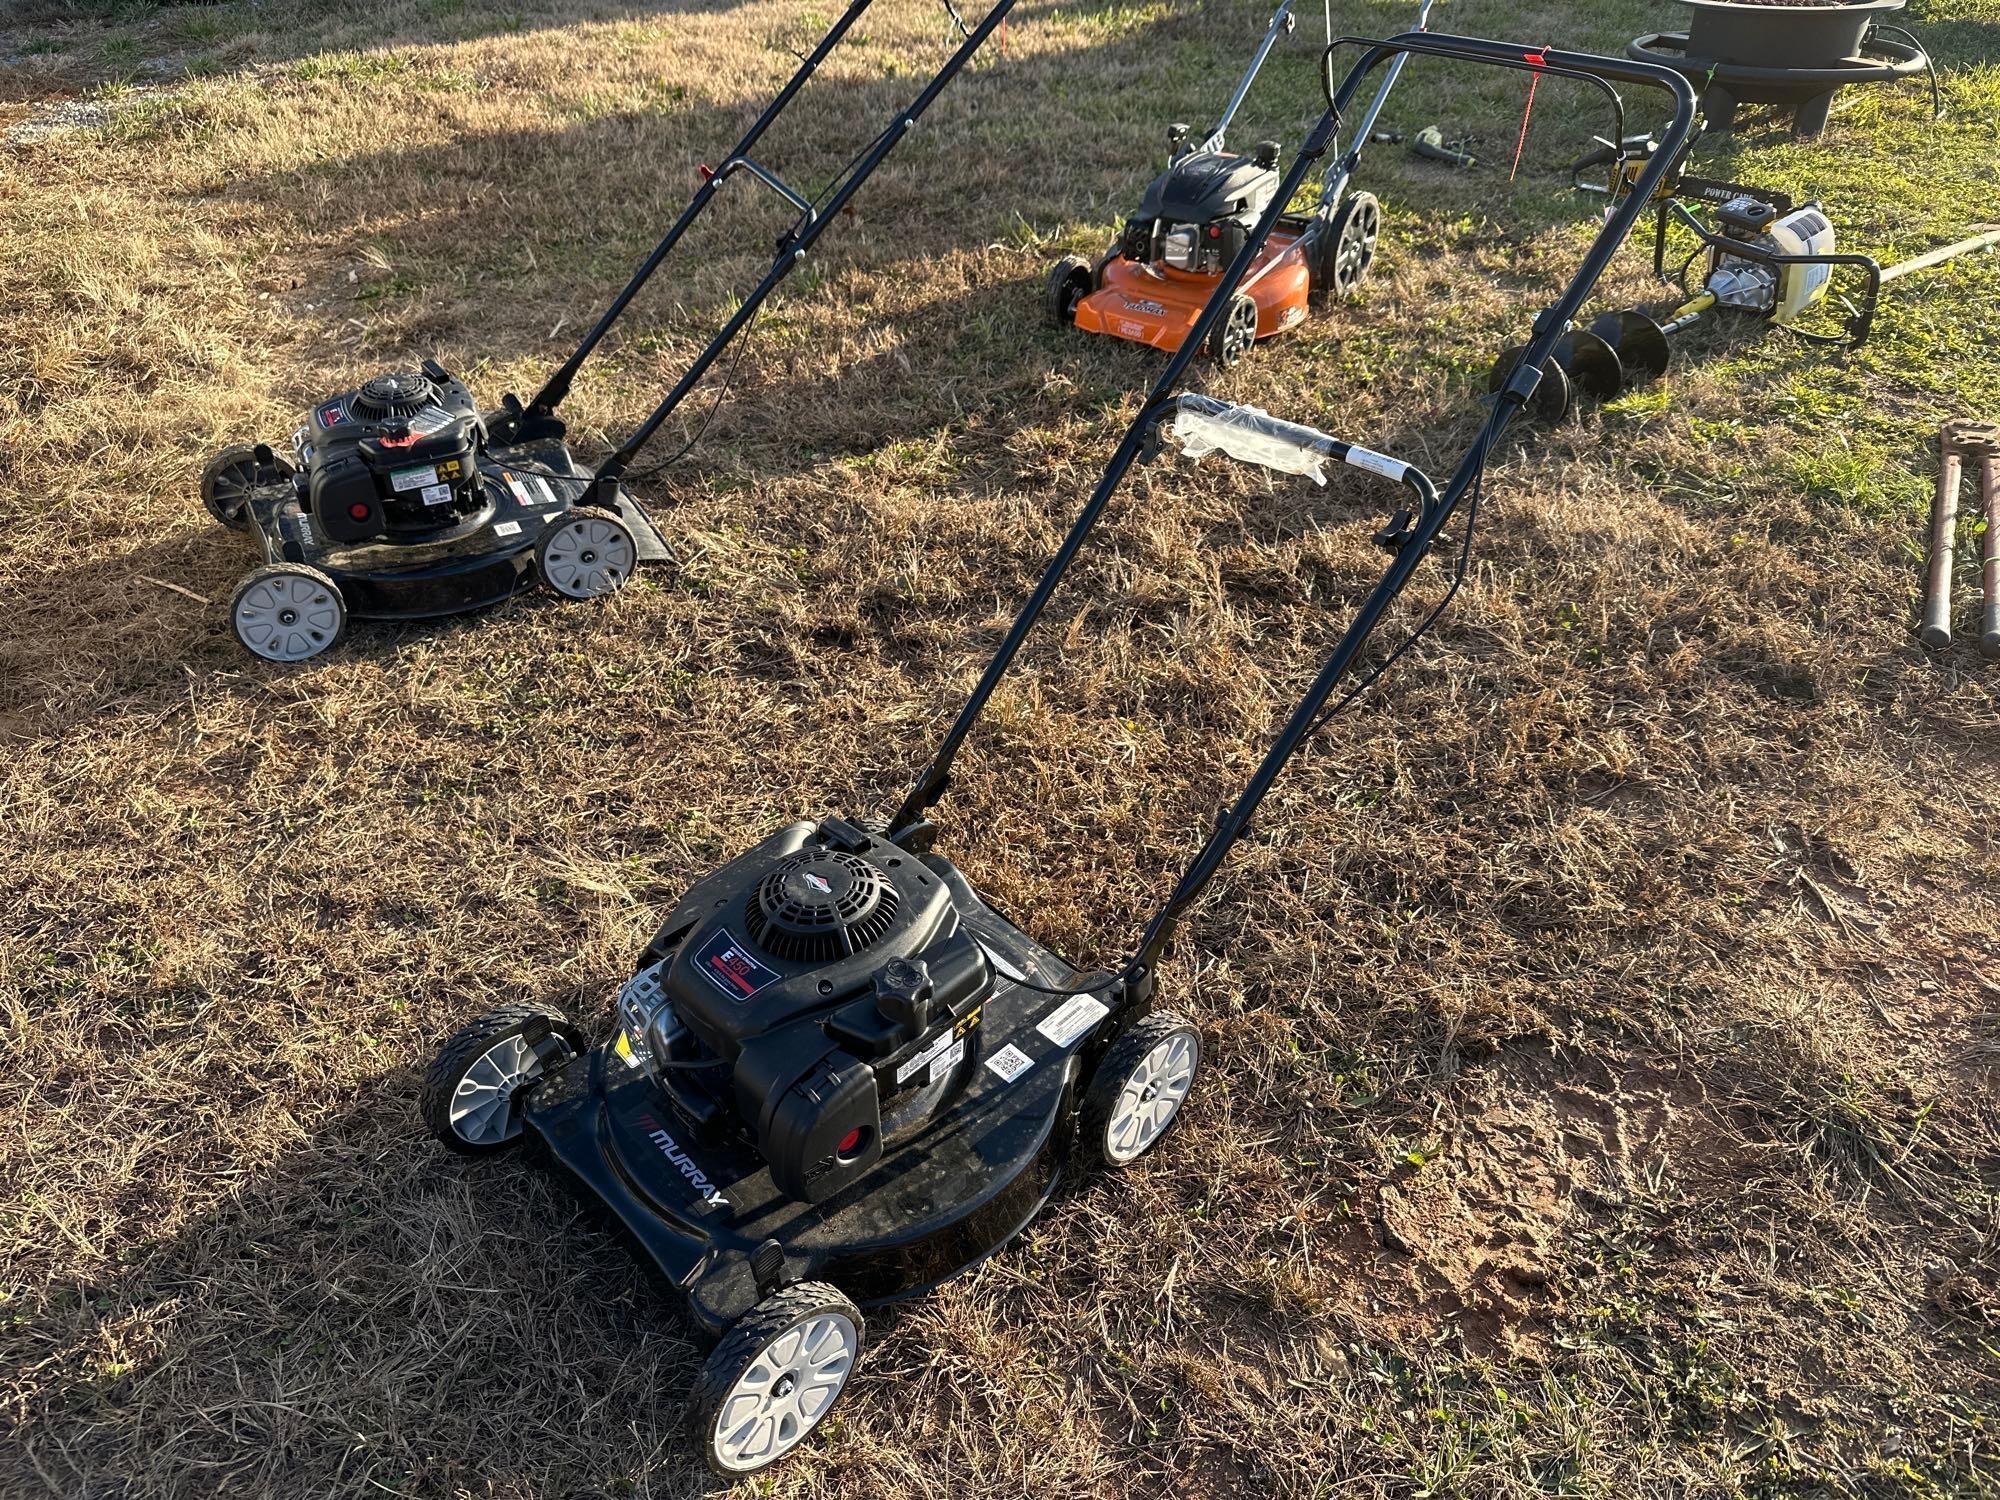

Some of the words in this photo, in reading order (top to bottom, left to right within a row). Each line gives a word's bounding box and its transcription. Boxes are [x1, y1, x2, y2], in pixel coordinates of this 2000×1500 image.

[1704, 187, 1732, 200] POWER
[297, 512, 316, 546] MURRAY
[720, 950, 751, 976] E450
[648, 1129, 730, 1204] MURRAY
